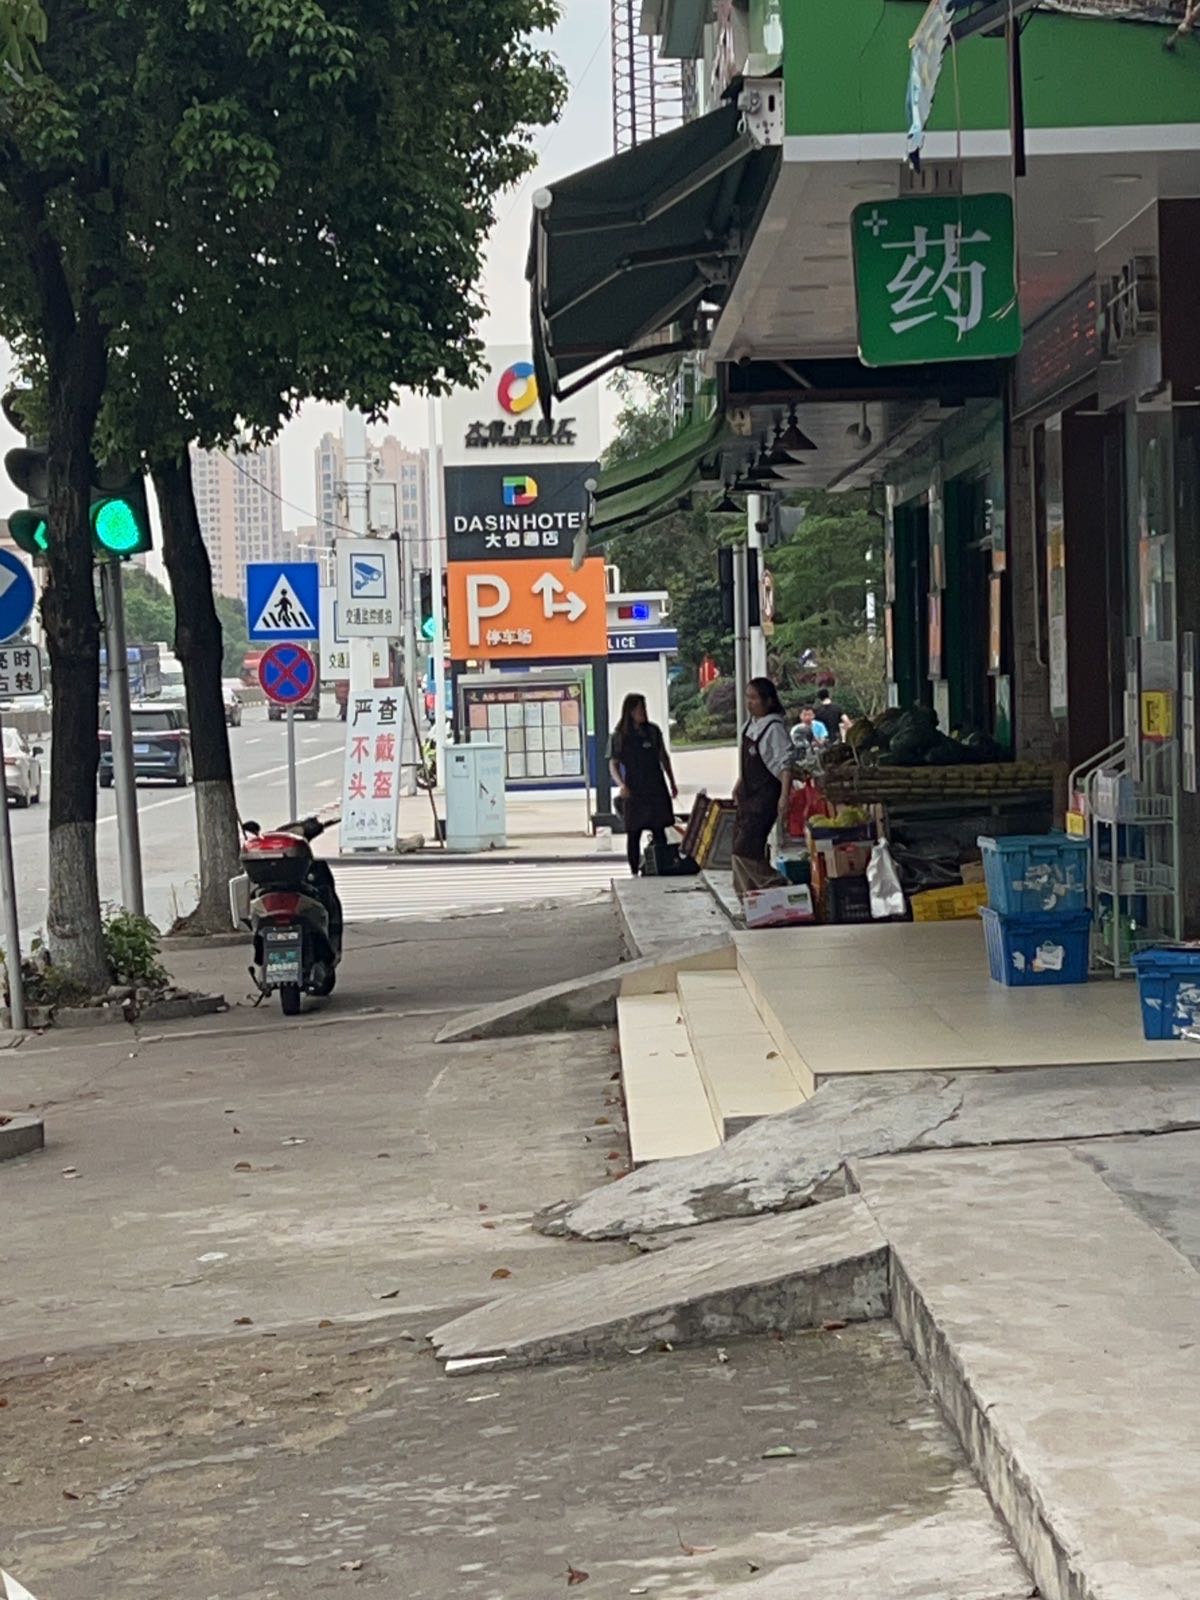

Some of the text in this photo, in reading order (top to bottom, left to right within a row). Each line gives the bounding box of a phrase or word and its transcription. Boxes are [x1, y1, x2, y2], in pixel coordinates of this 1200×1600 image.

[882, 224, 991, 335] 药
[352, 696, 397, 727] 严查
[350, 732, 396, 765] 不戴
[348, 771, 393, 801] 头盔
